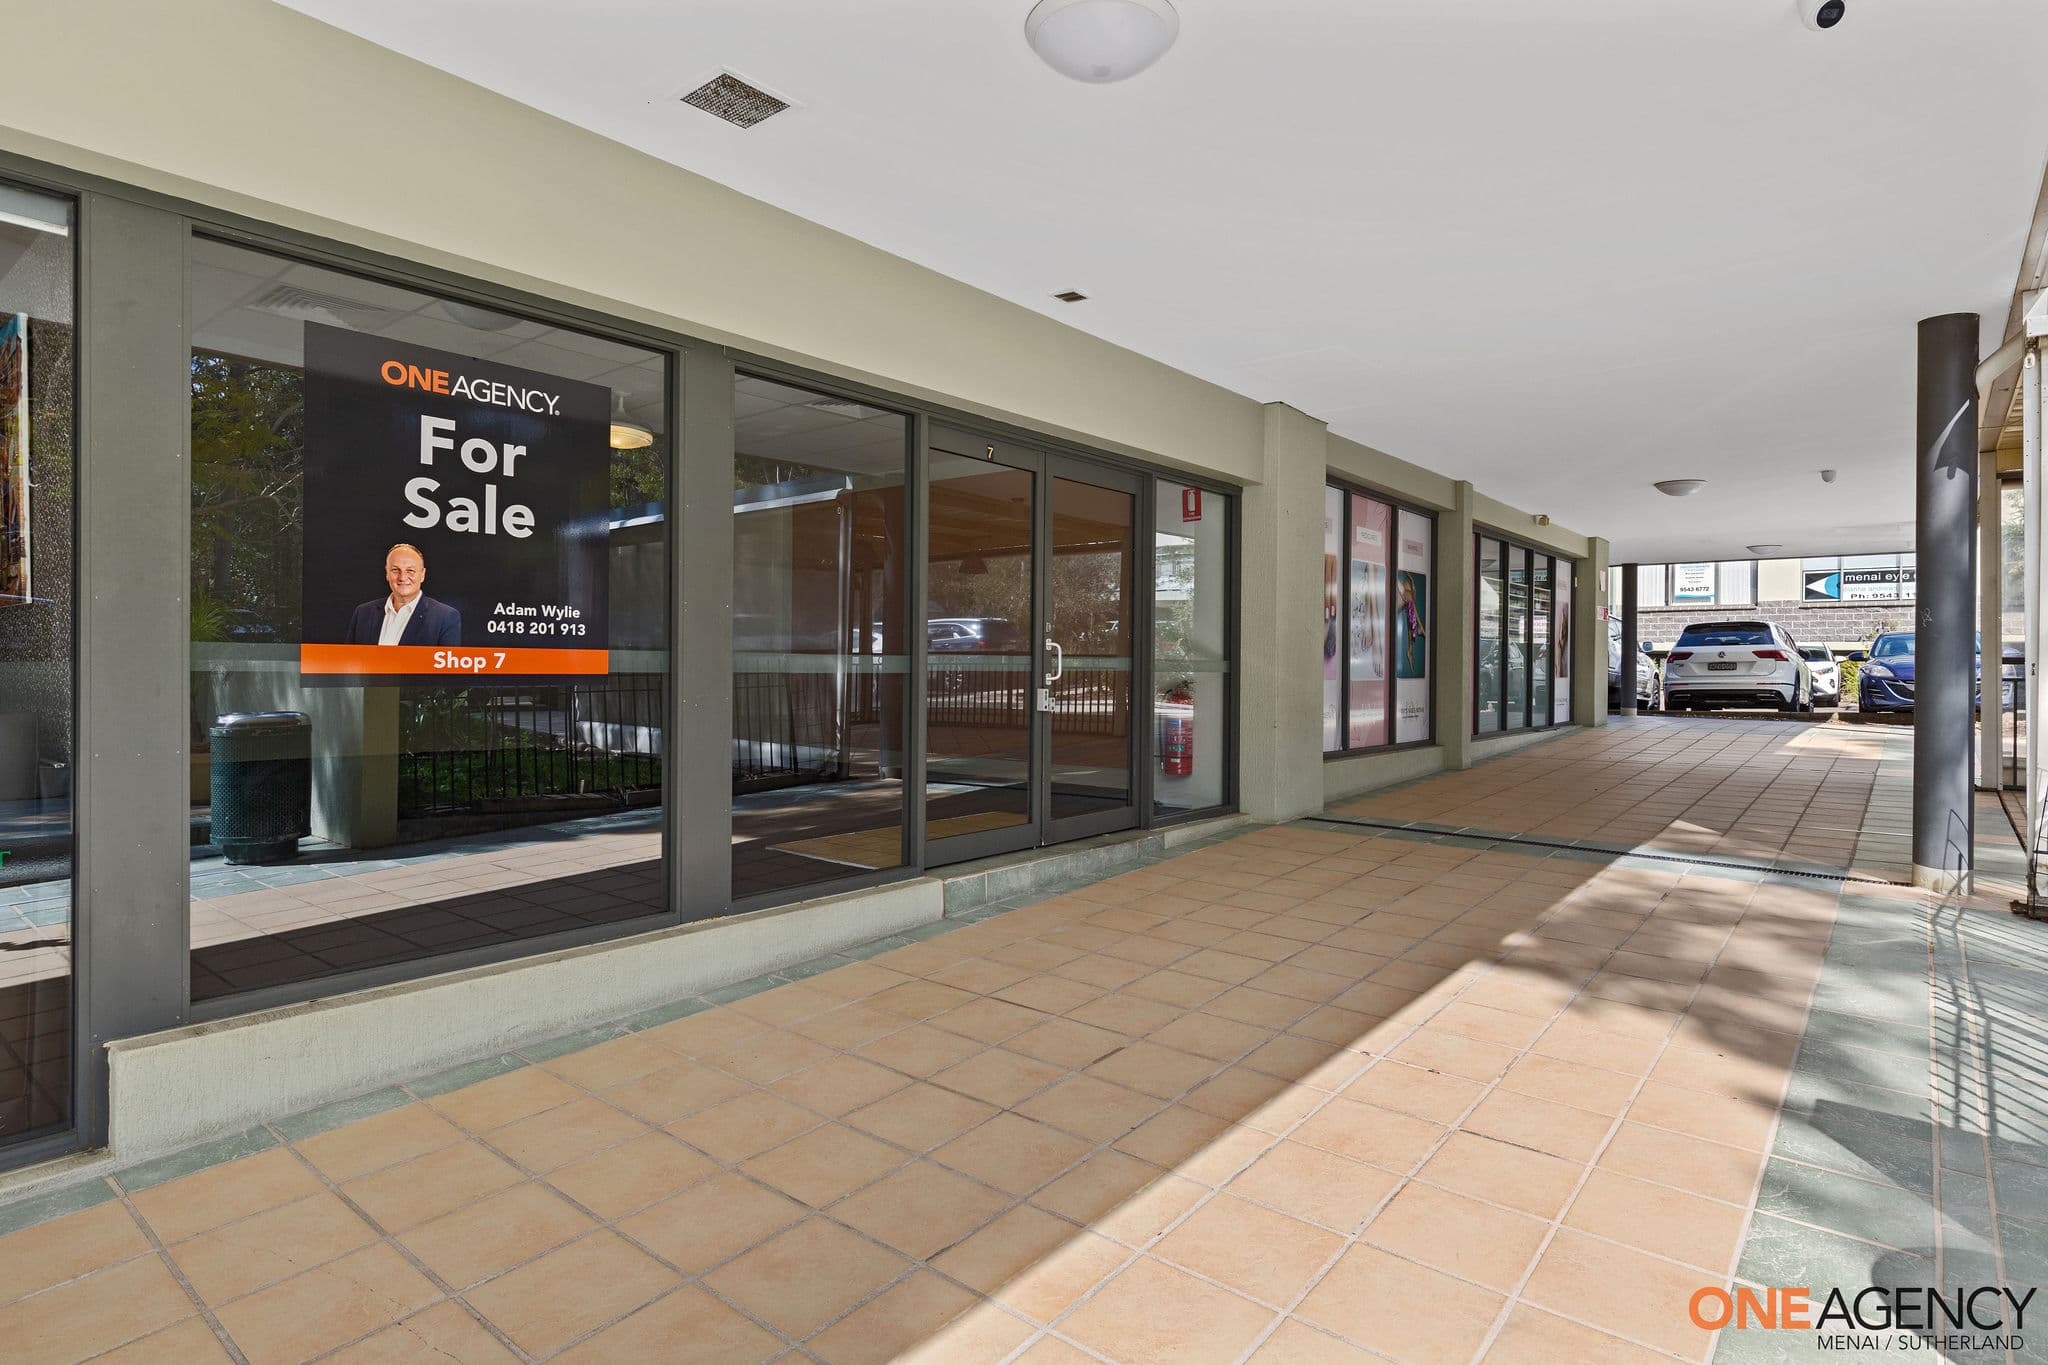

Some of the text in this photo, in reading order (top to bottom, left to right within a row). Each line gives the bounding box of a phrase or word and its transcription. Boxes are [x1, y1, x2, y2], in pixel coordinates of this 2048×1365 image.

[420, 414, 527, 477] For
[986, 446, 994, 459] 7
[402, 476, 536, 539] Sale
[1845, 572, 1881, 582] menai
[1885, 572, 1910, 582] eye
[493, 602, 581, 621] Adam Wylie
[487, 620, 586, 636] 0418 201 913
[433, 651, 506, 673] Shop 7
